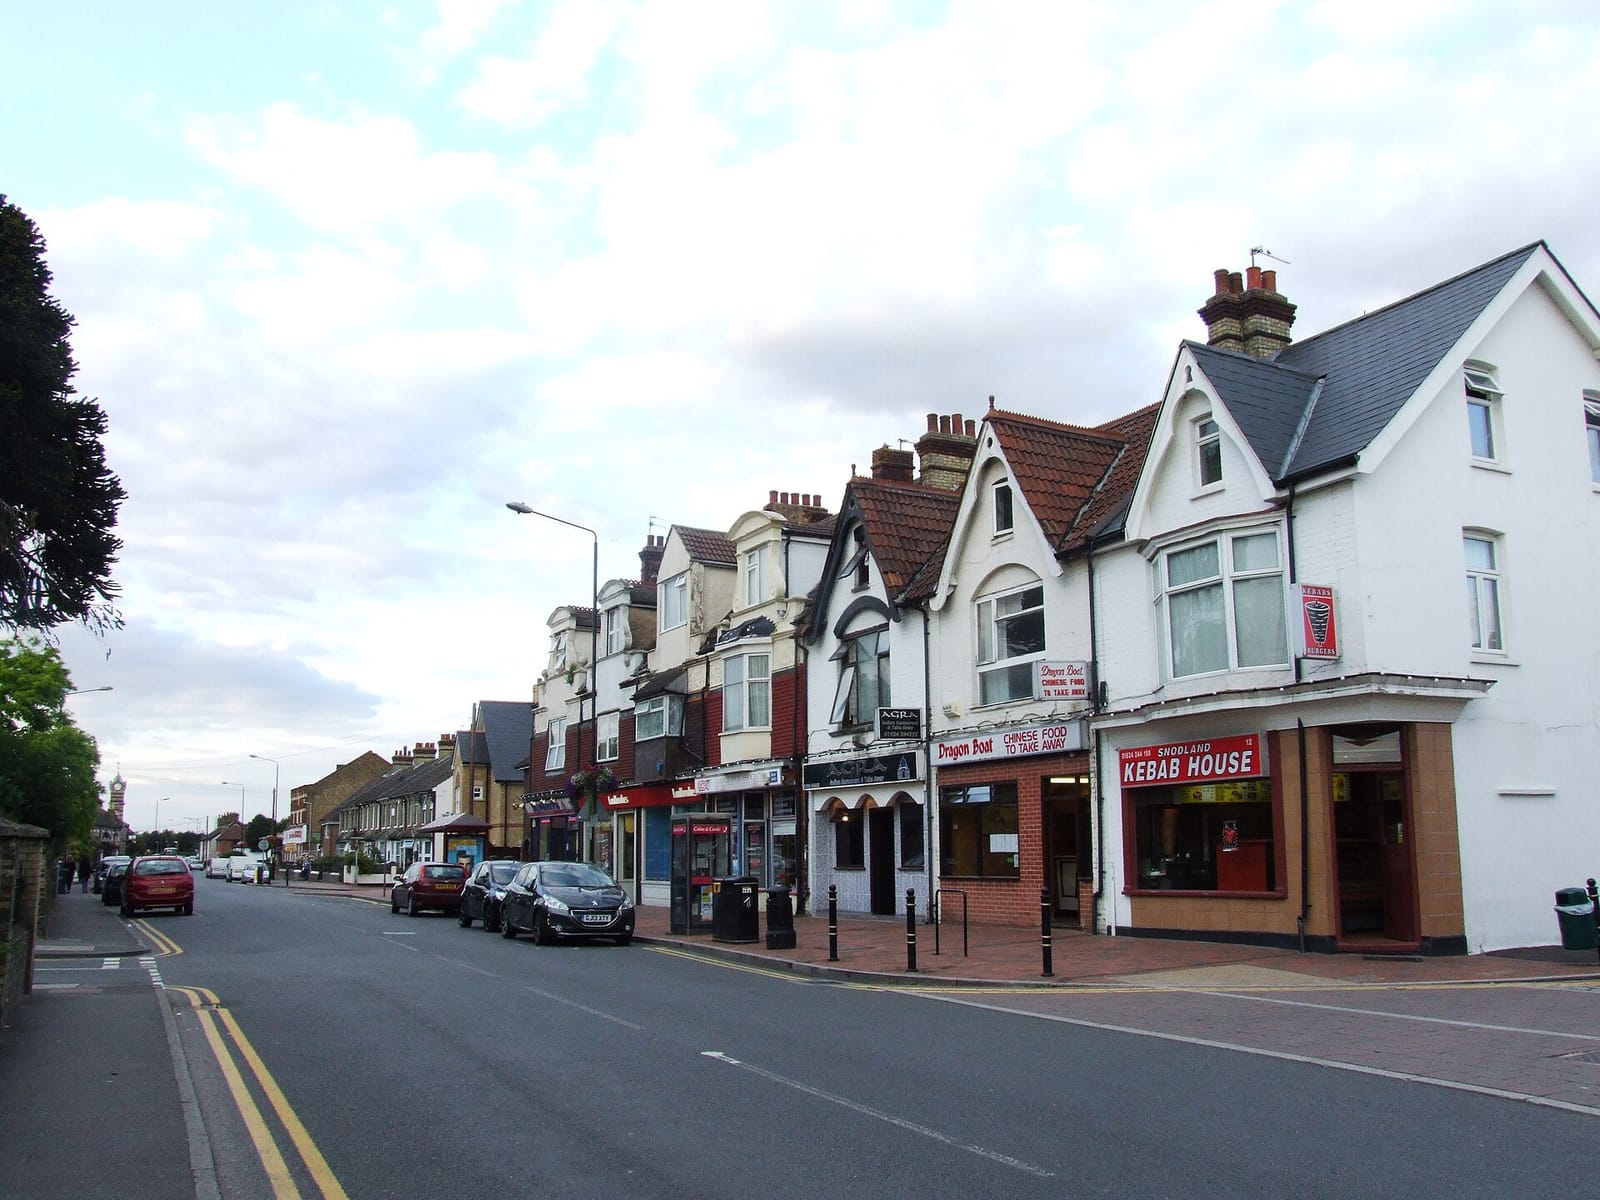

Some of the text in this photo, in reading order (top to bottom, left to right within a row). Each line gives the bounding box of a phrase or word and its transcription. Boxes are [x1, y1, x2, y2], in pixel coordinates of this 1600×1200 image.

[1302, 587, 1331, 596] KEBABS
[1306, 647, 1336, 655] BURGERS
[1040, 664, 1084, 677] Dragon Boat
[881, 711, 918, 719] AGRA
[1003, 726, 1067, 744] CHINESE FOOD
[938, 738, 994, 760] Dragon Boat
[1005, 738, 1066, 755] TO TAKE AWAY
[1157, 743, 1211, 757] SNODLAND
[827, 758, 888, 777] AGRA
[1123, 750, 1253, 782] KEBAB HOUSE
